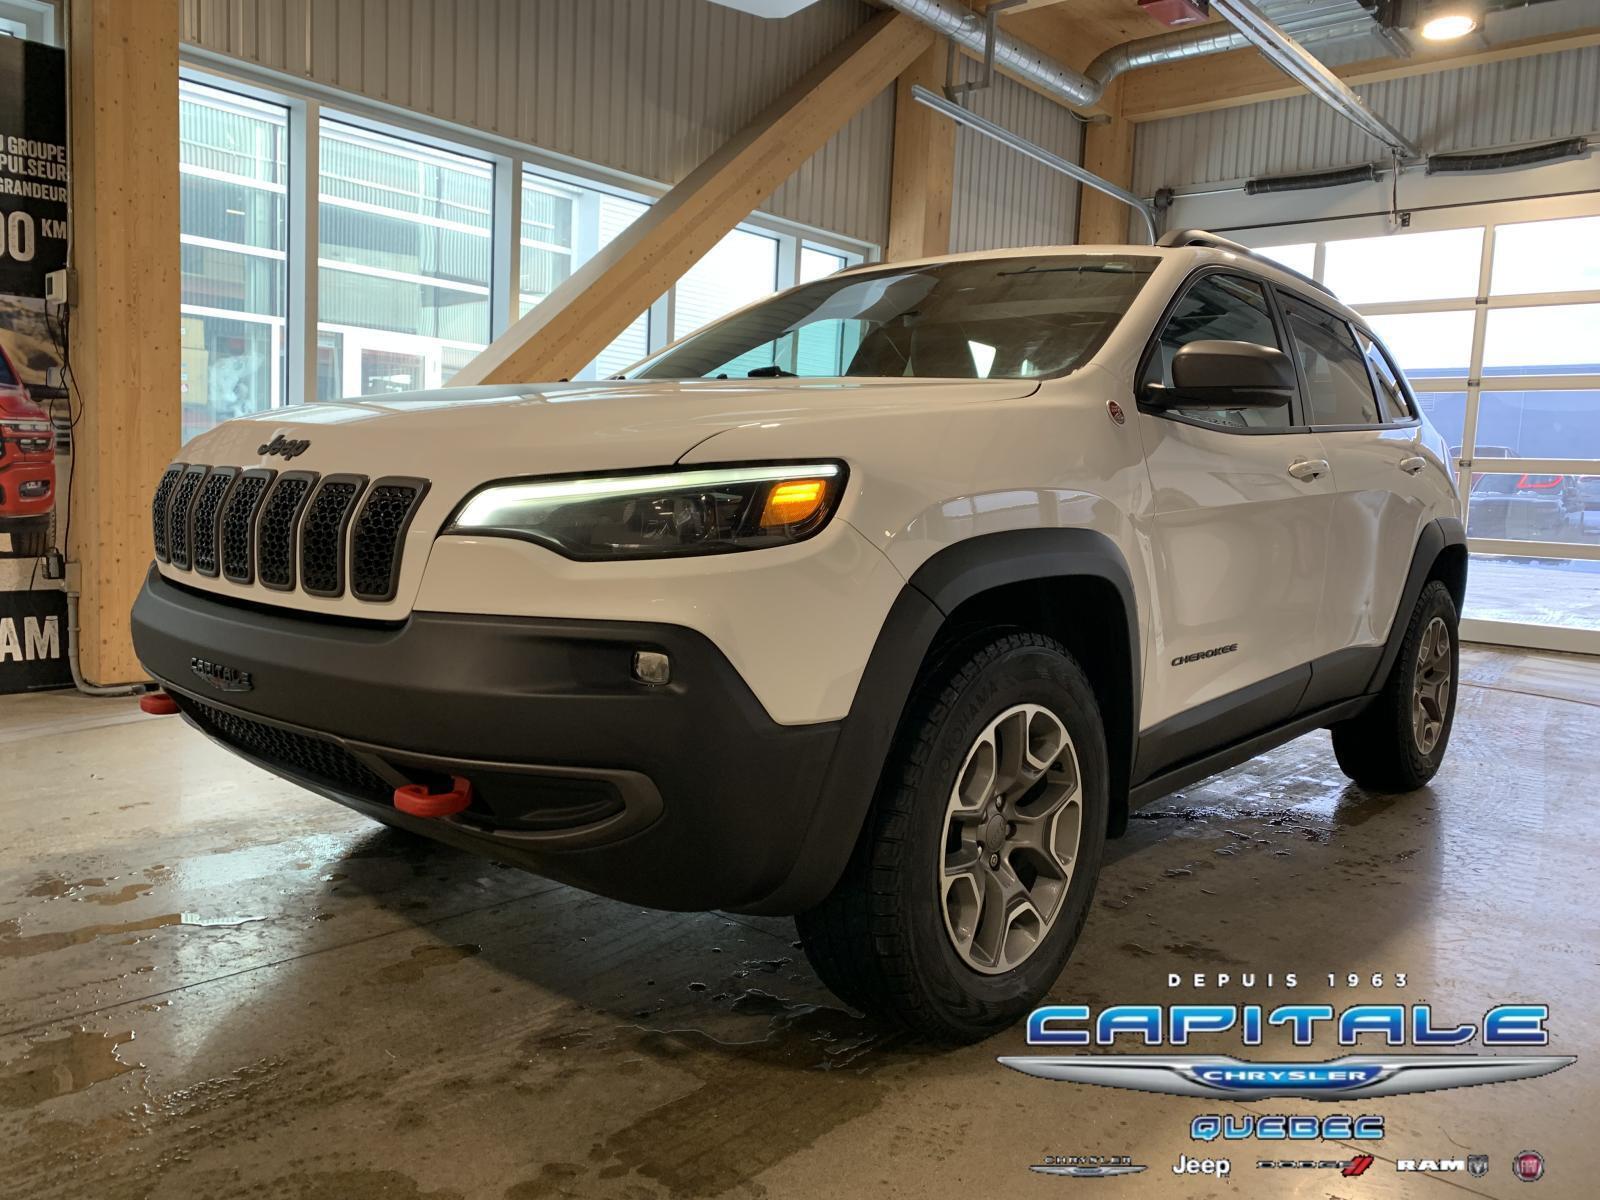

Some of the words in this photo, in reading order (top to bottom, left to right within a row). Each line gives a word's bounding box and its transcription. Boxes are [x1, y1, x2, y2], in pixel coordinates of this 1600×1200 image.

[8, 135, 66, 163] GROUPE
[0, 211, 35, 261] 0
[41, 218, 67, 239] KM
[257, 434, 311, 461] Jeep
[1171, 643, 1239, 667] CHEROKEE
